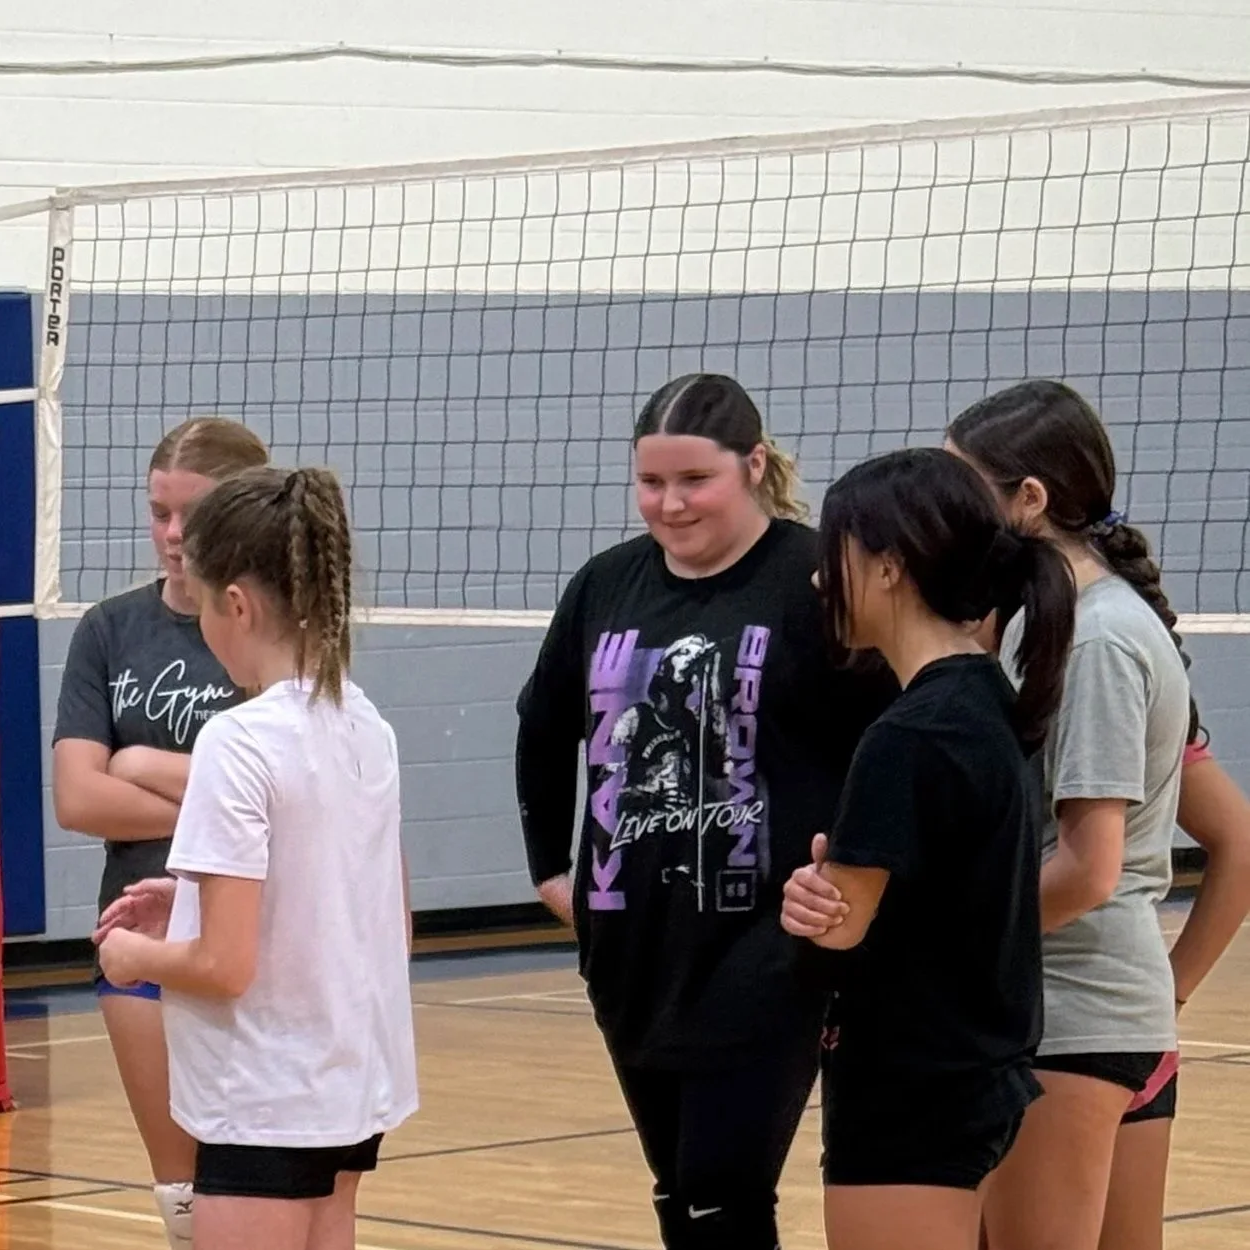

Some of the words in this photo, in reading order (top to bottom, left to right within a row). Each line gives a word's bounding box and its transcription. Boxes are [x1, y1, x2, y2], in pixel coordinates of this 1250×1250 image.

[45, 246, 65, 347] PORTER
[108, 668, 145, 723] the
[145, 659, 234, 745] Gym
[726, 624, 772, 868] BROWN
[588, 629, 640, 911] KANE
[609, 811, 665, 851] LIVE
[665, 806, 699, 833] ON
[700, 800, 764, 837] TOUR
